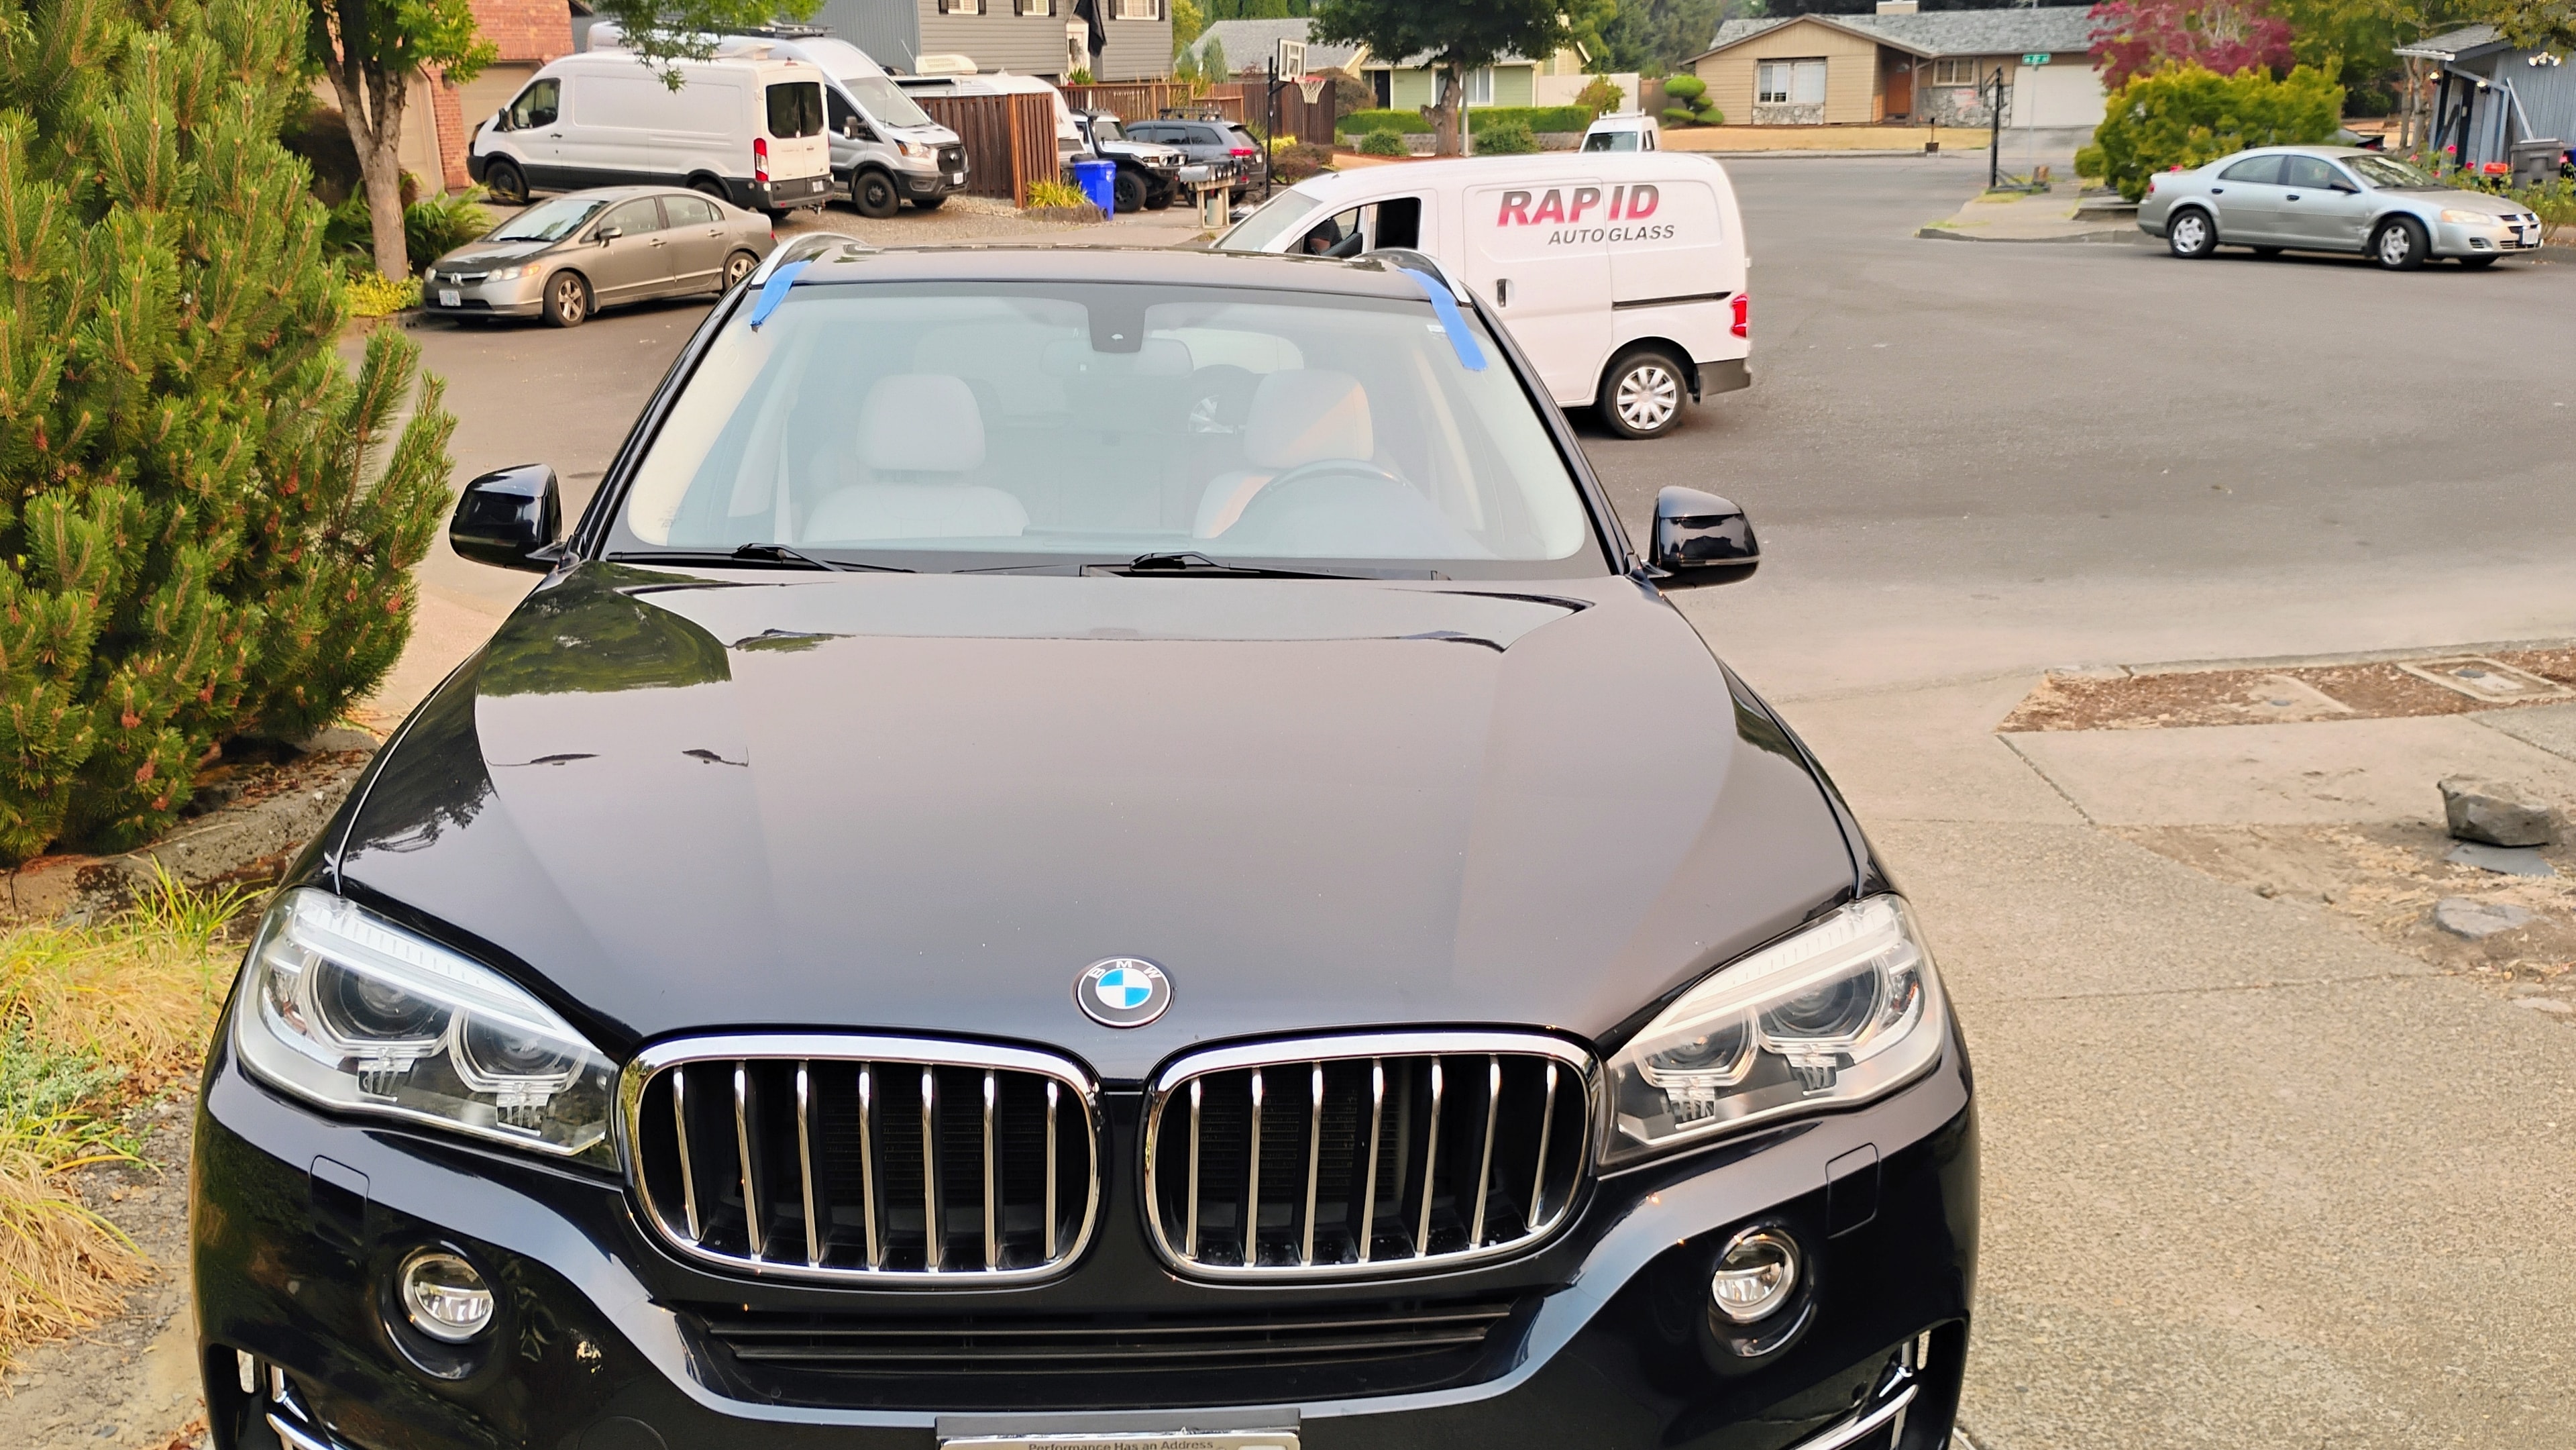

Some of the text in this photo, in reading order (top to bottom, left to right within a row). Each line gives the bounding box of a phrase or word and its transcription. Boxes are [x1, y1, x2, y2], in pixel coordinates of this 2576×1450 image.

[1497, 185, 1660, 227] RAPID
[1088, 960, 1161, 979] BMW
[1114, 1442, 1138, 1450] Has
[1161, 1441, 1214, 1449] Address
